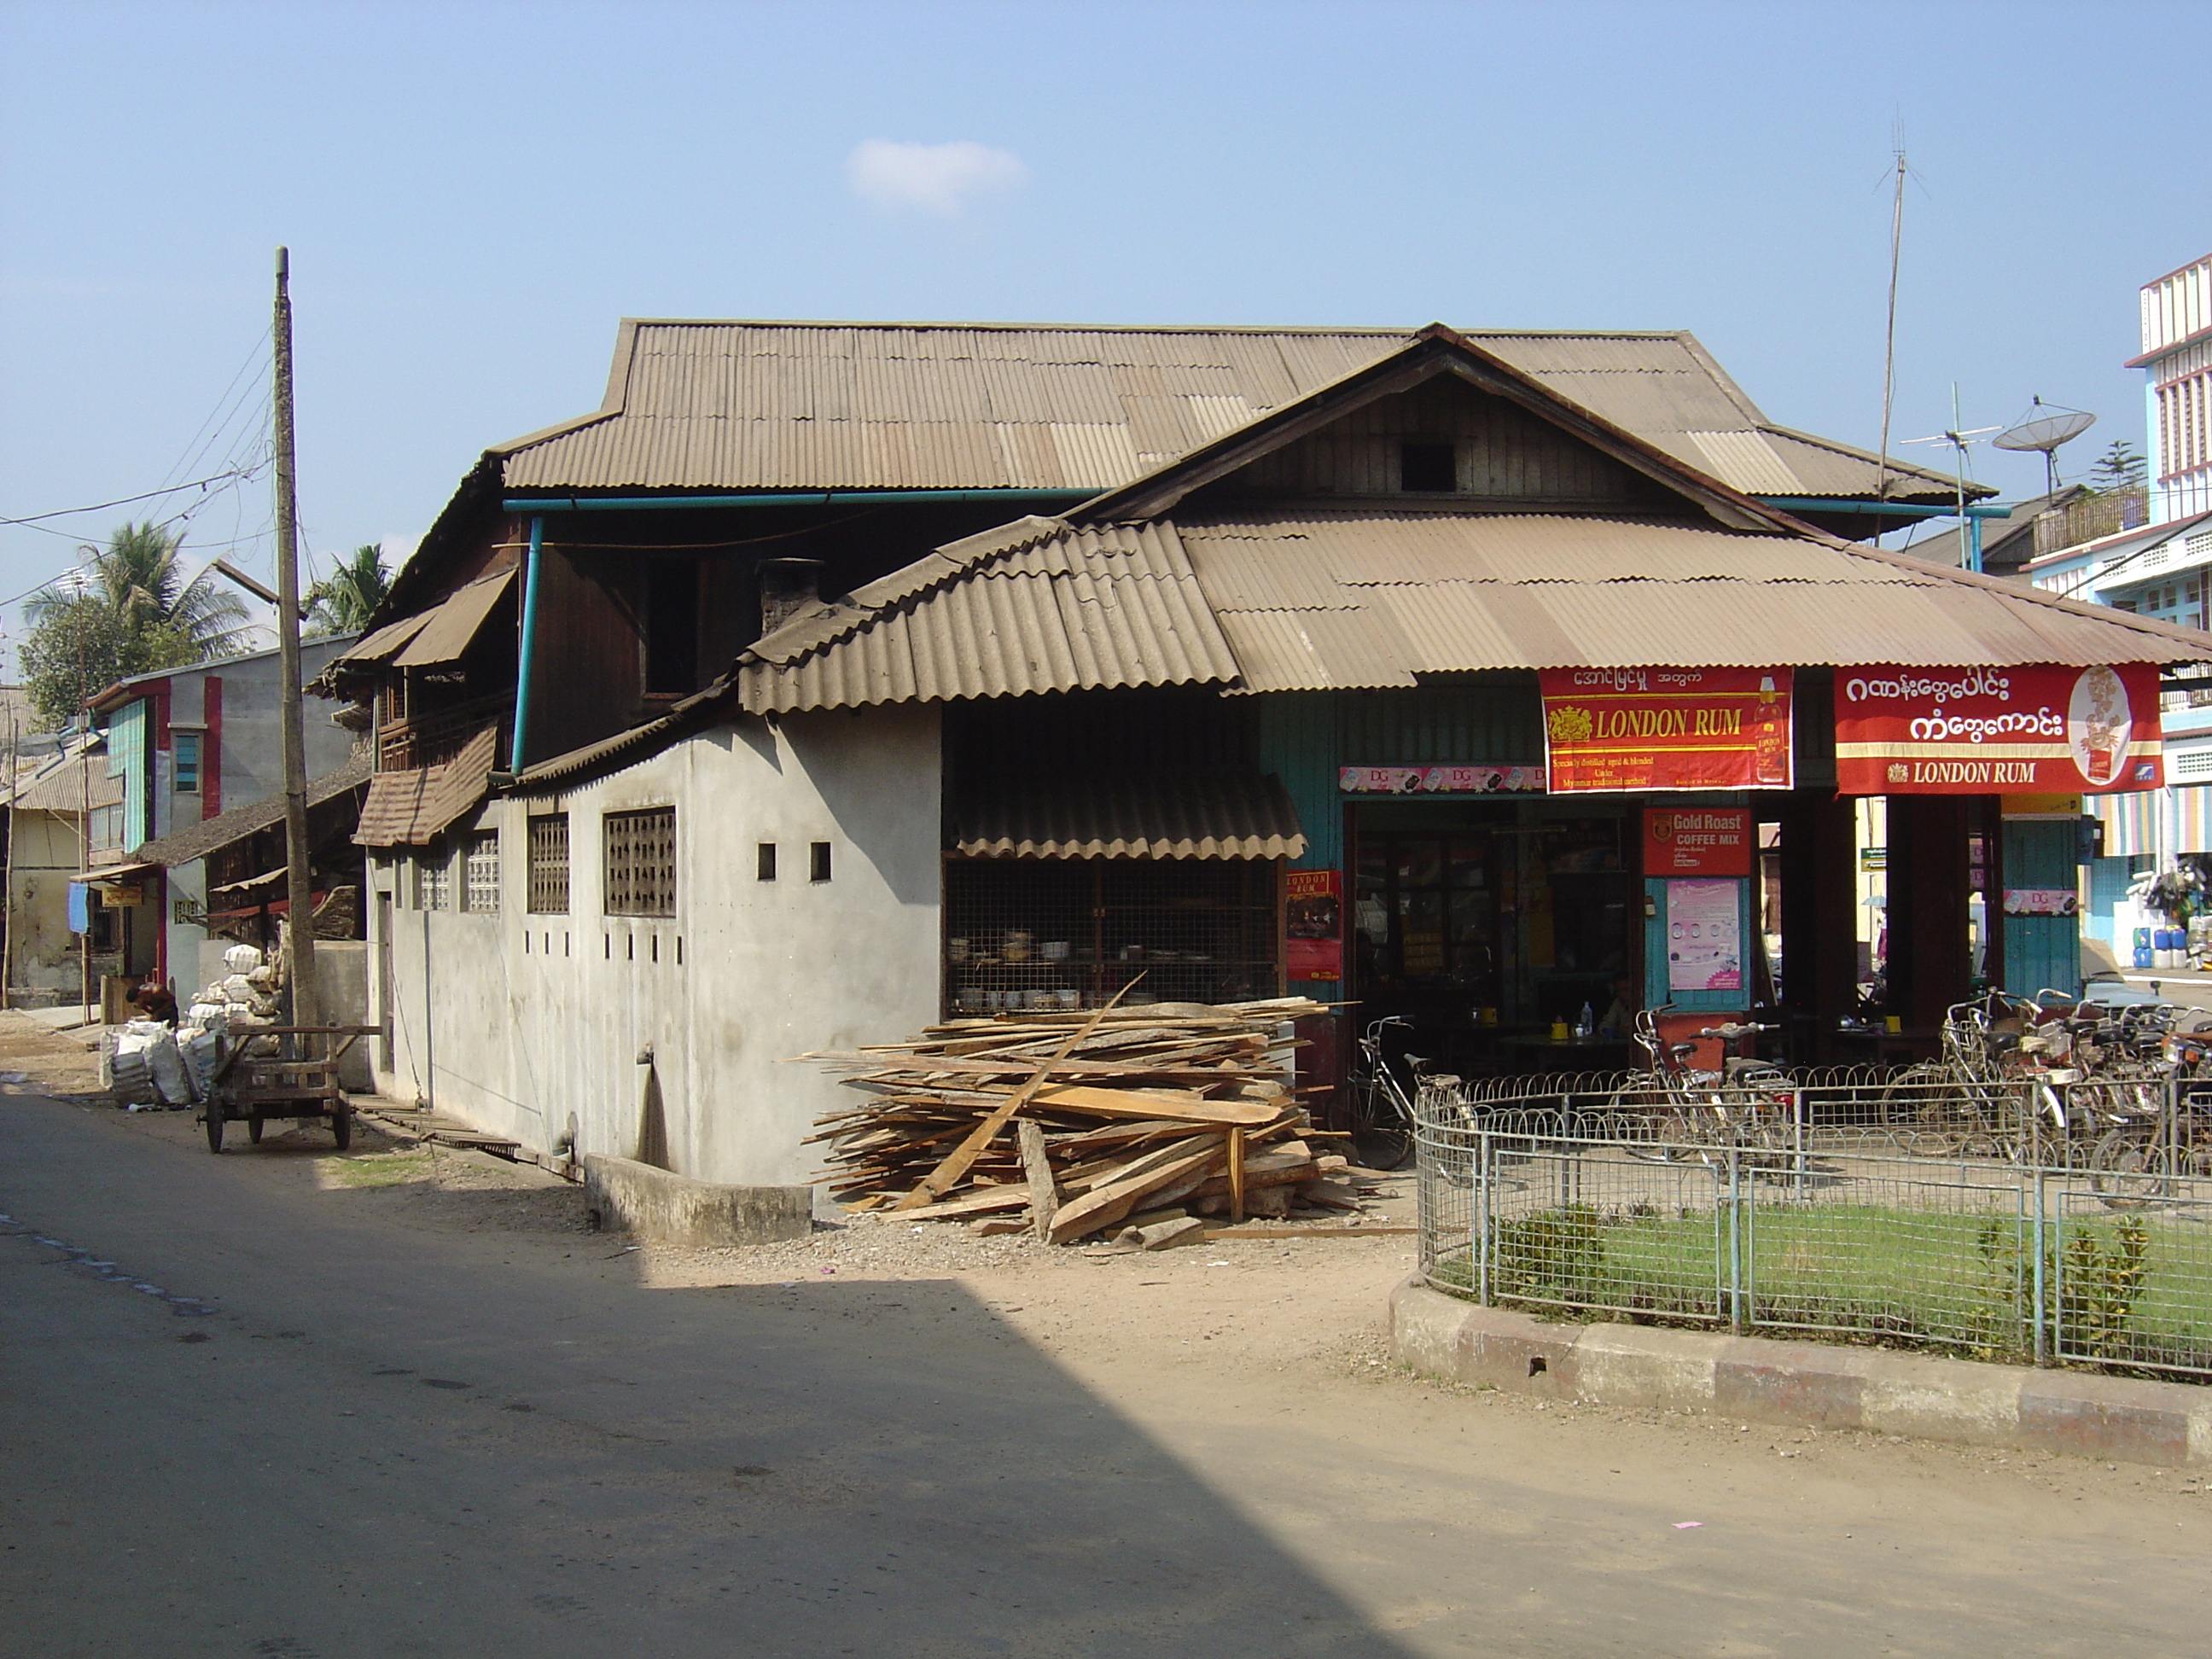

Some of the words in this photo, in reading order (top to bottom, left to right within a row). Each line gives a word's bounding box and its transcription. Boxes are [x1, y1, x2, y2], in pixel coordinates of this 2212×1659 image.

[1596, 708, 1689, 738] LONDON
[1694, 708, 1742, 736] RUM
[1910, 707, 2064, 743] ကံတွေကောင်း
[1370, 771, 1388, 782] DG
[1452, 770, 1471, 781] DG
[1913, 762, 1991, 783] LONDON
[1994, 762, 2036, 783] RUM
[1674, 814, 1702, 830] Gold
[1704, 814, 1741, 830] Roast
[1677, 834, 1716, 845] COFFEE
[1719, 834, 1739, 845] MIX
[1287, 874, 1326, 885] LONDON
[1296, 884, 1315, 893] RUM
[2032, 893, 2048, 904] DG
